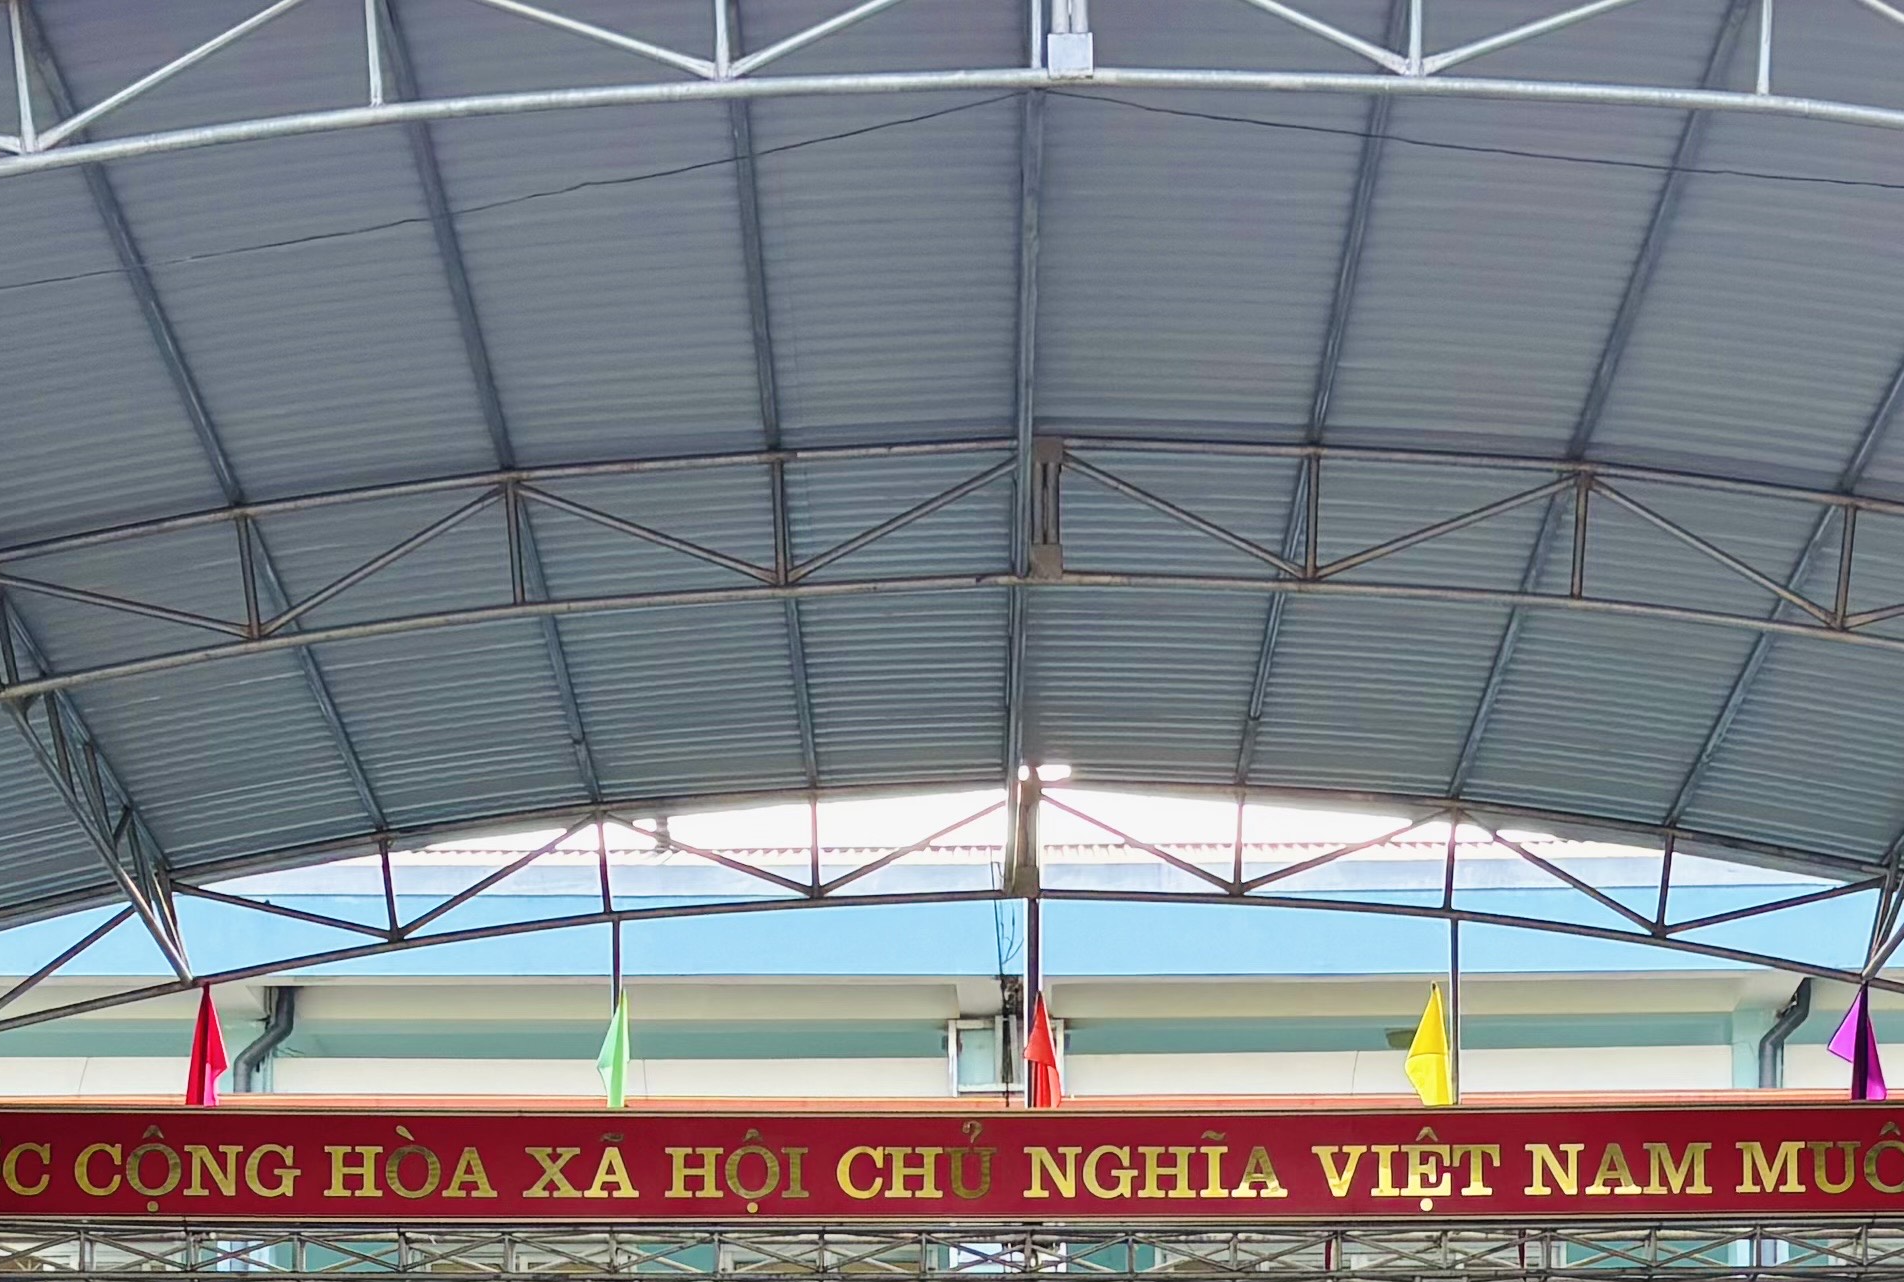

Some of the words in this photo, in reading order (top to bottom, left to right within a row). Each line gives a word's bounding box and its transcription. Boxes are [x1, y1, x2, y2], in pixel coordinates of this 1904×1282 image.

[74, 1124, 301, 1213] CỘNG
[323, 1125, 498, 1199] HÒA
[522, 1132, 640, 1199] XÃ
[664, 1129, 810, 1214] HỘI
[836, 1121, 994, 1200] CHỦ
[1022, 1130, 1289, 1199] NGHĨA
[1311, 1126, 1501, 1212] VIỆT
[1524, 1141, 1712, 1197] NAM
